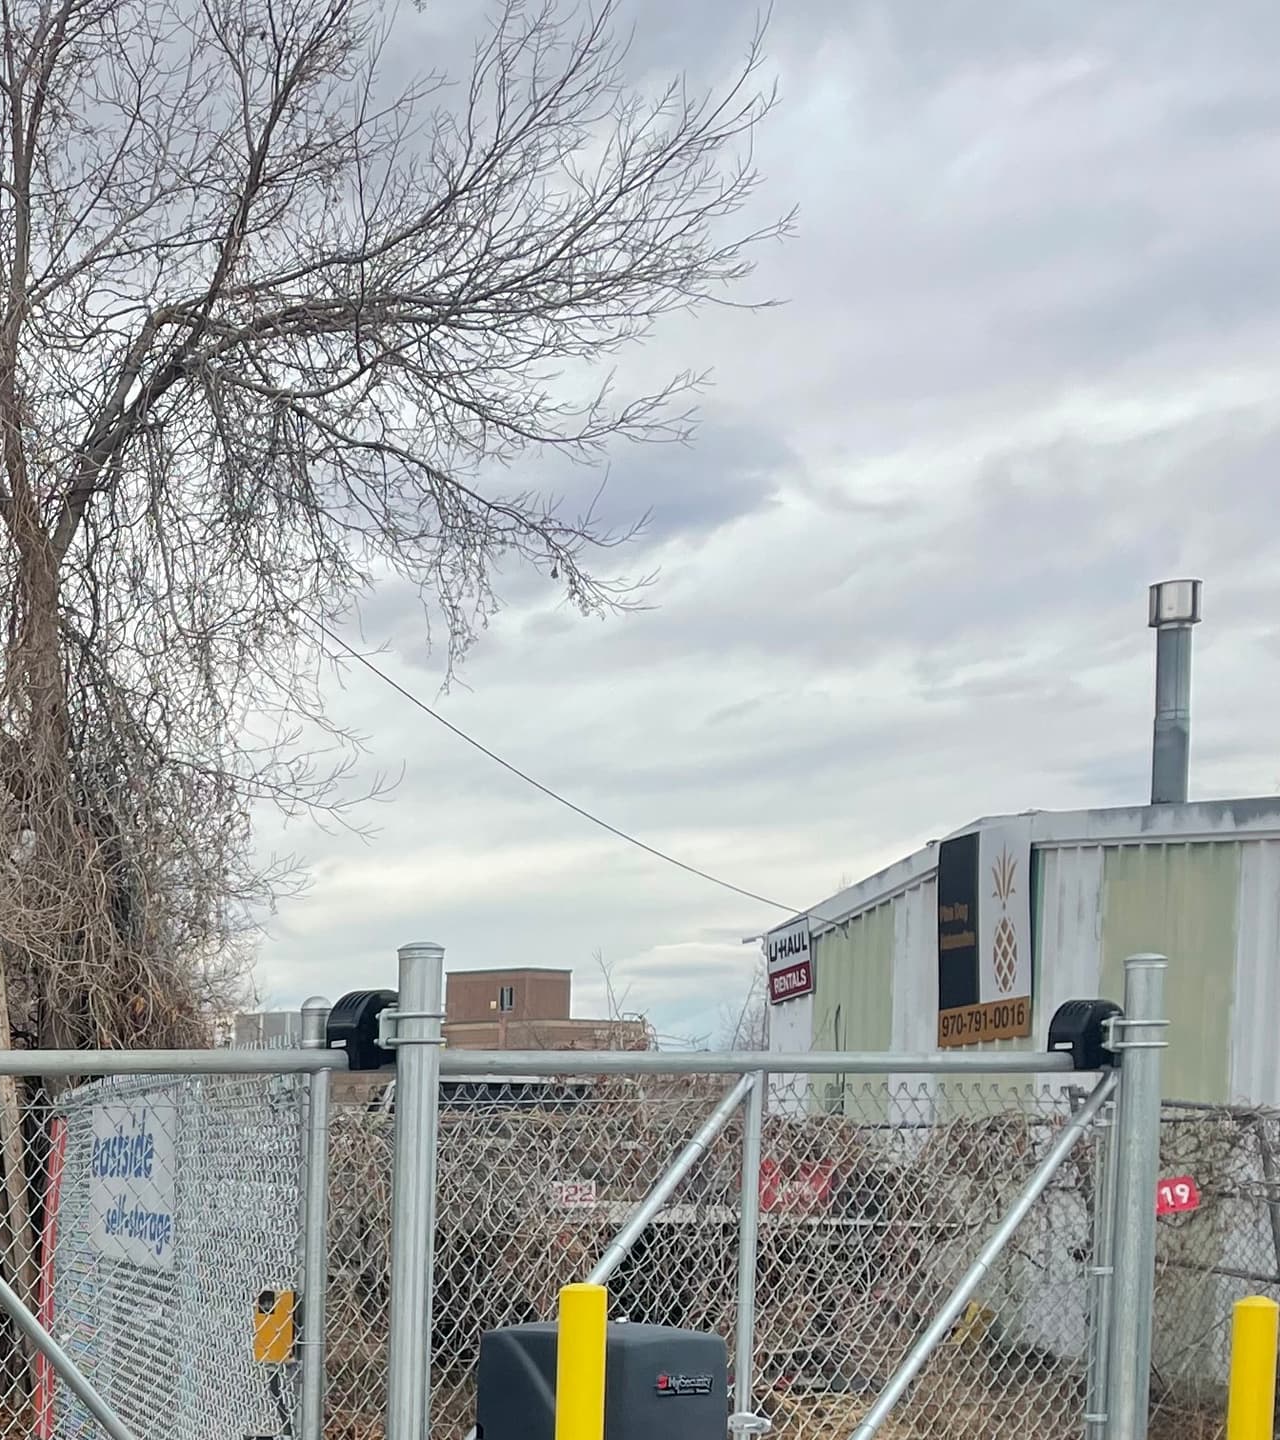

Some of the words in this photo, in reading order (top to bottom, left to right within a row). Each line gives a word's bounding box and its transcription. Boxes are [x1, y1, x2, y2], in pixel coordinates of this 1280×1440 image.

[769, 930, 808, 962] U-HAUL
[773, 968, 807, 994] RENTALS
[942, 1002, 1025, 1037] 970-791-0016
[92, 1109, 153, 1179] eastside
